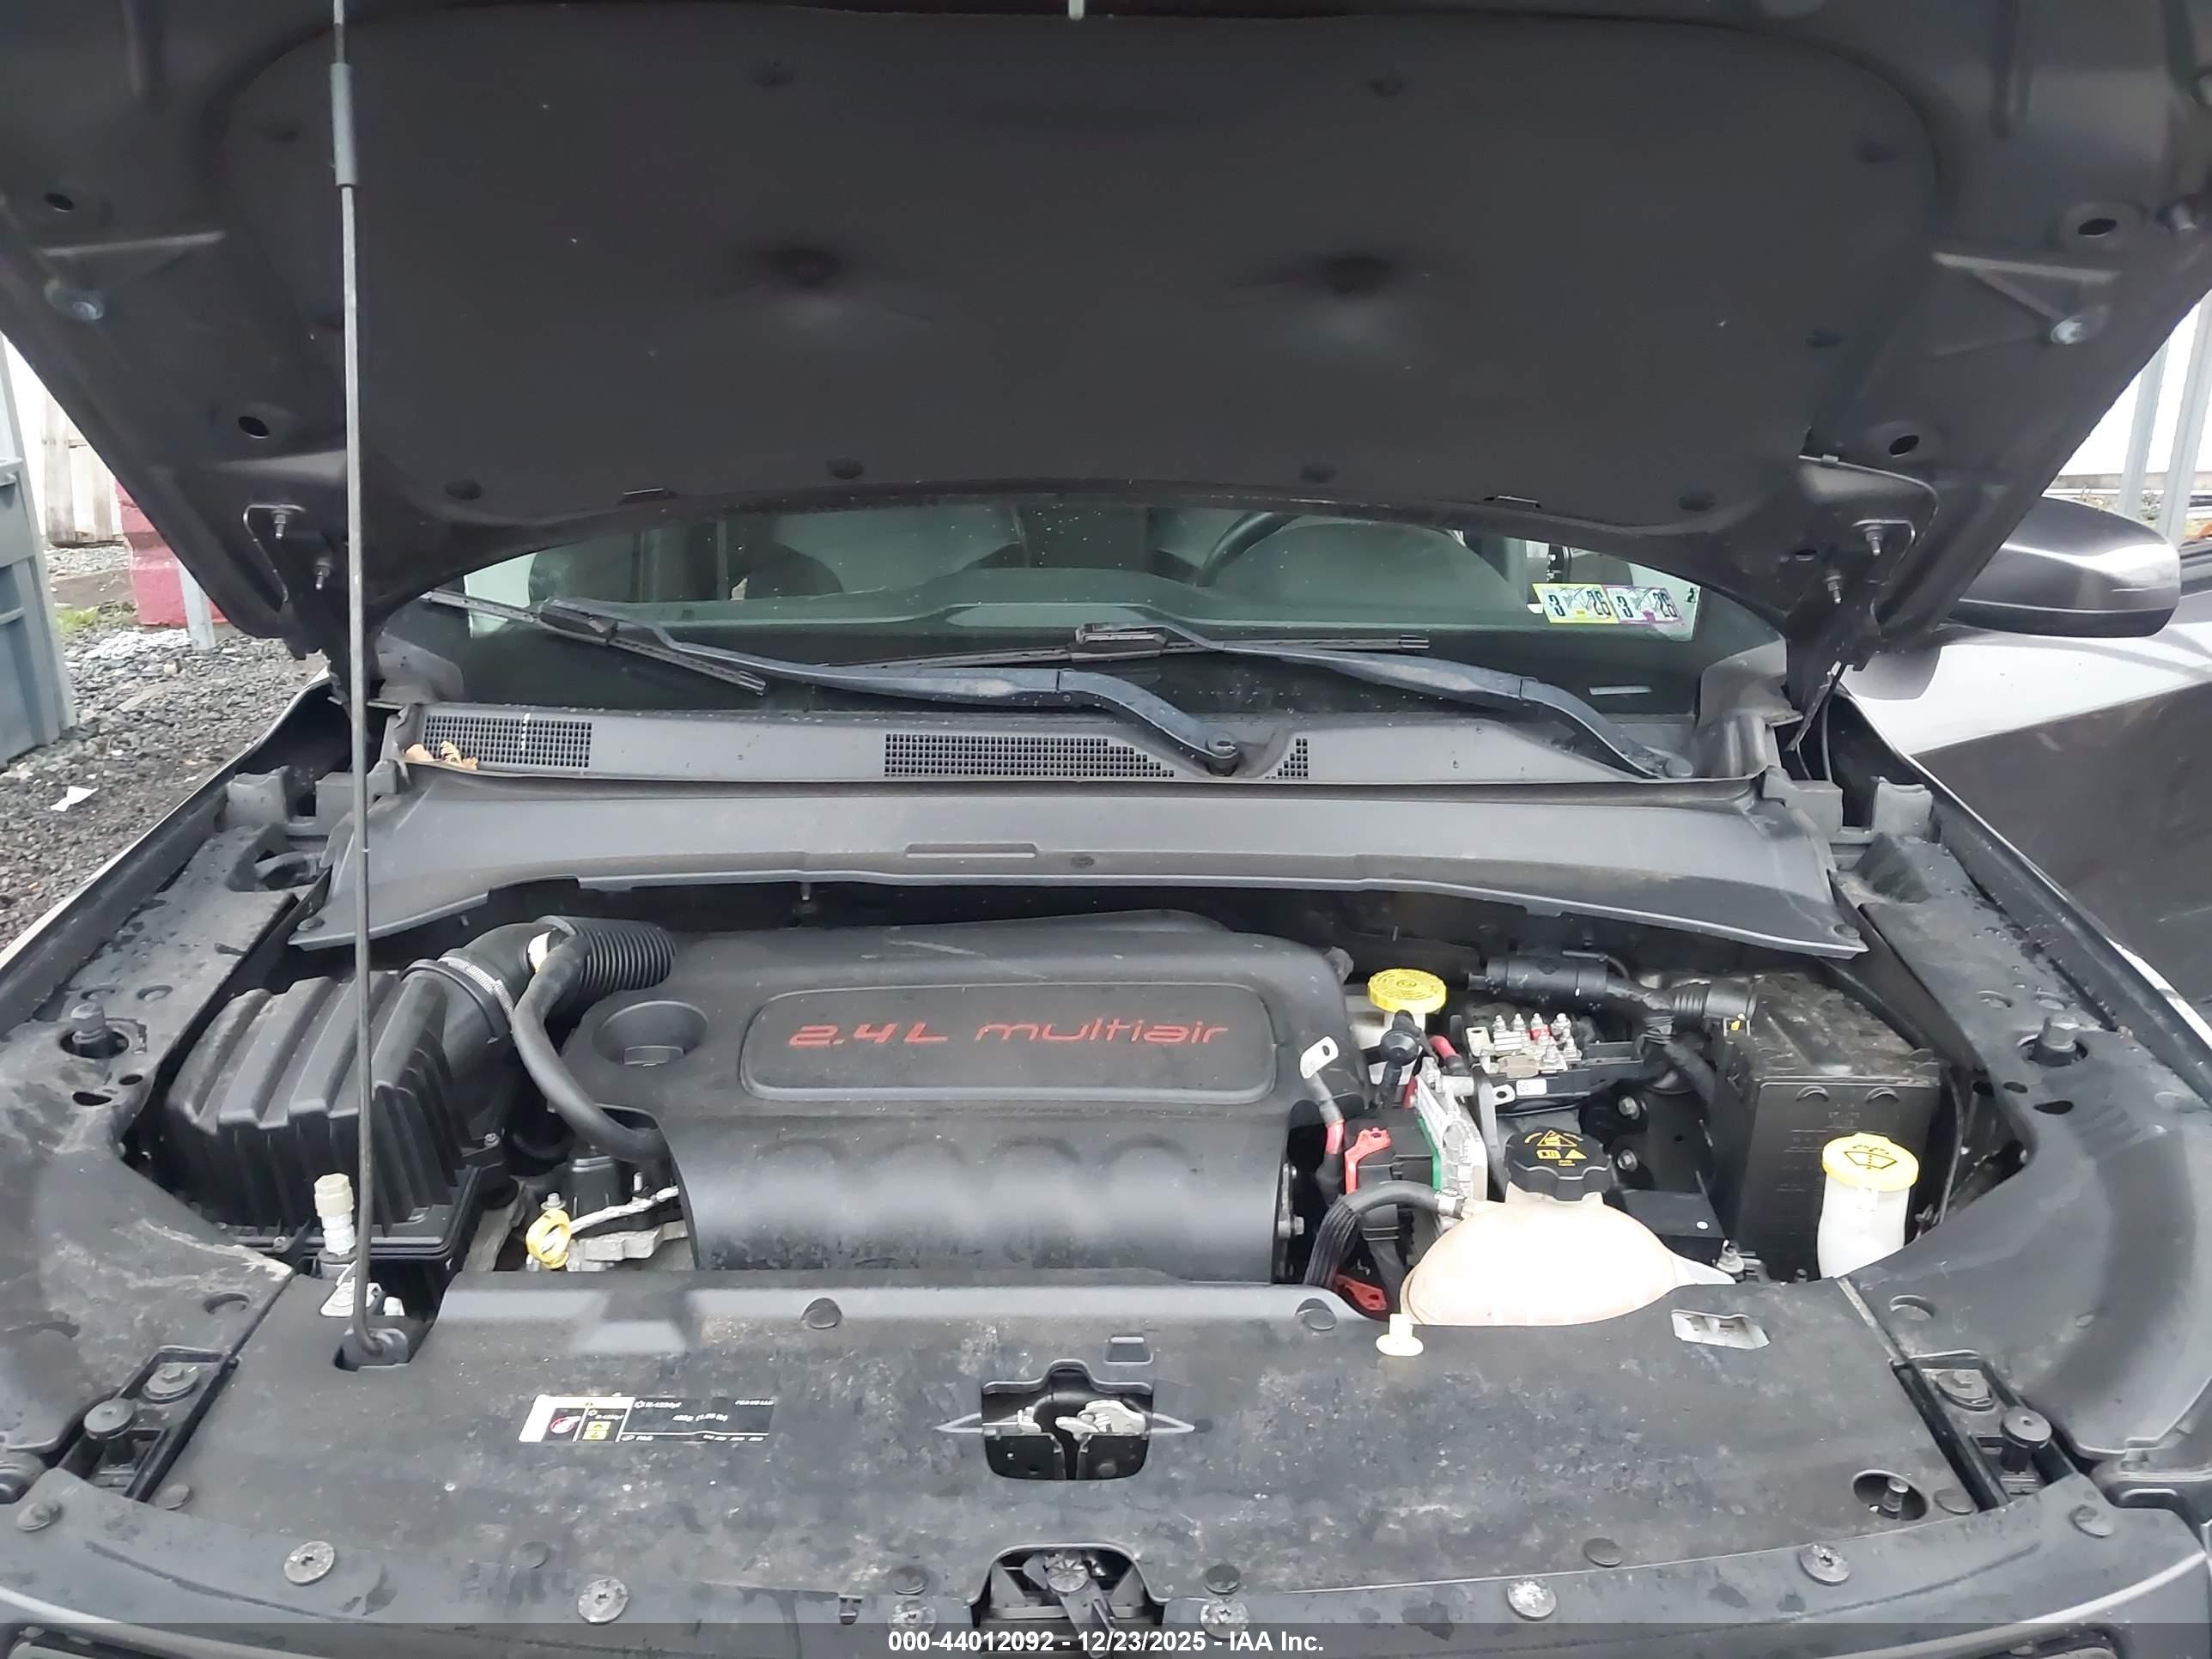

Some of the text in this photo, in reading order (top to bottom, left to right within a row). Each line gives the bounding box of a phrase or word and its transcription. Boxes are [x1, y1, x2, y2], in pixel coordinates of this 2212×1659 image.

[1548, 590, 1612, 617] 3 26
[1616, 592, 1678, 618] 3 26
[975, 1018, 1230, 1045] multiair
